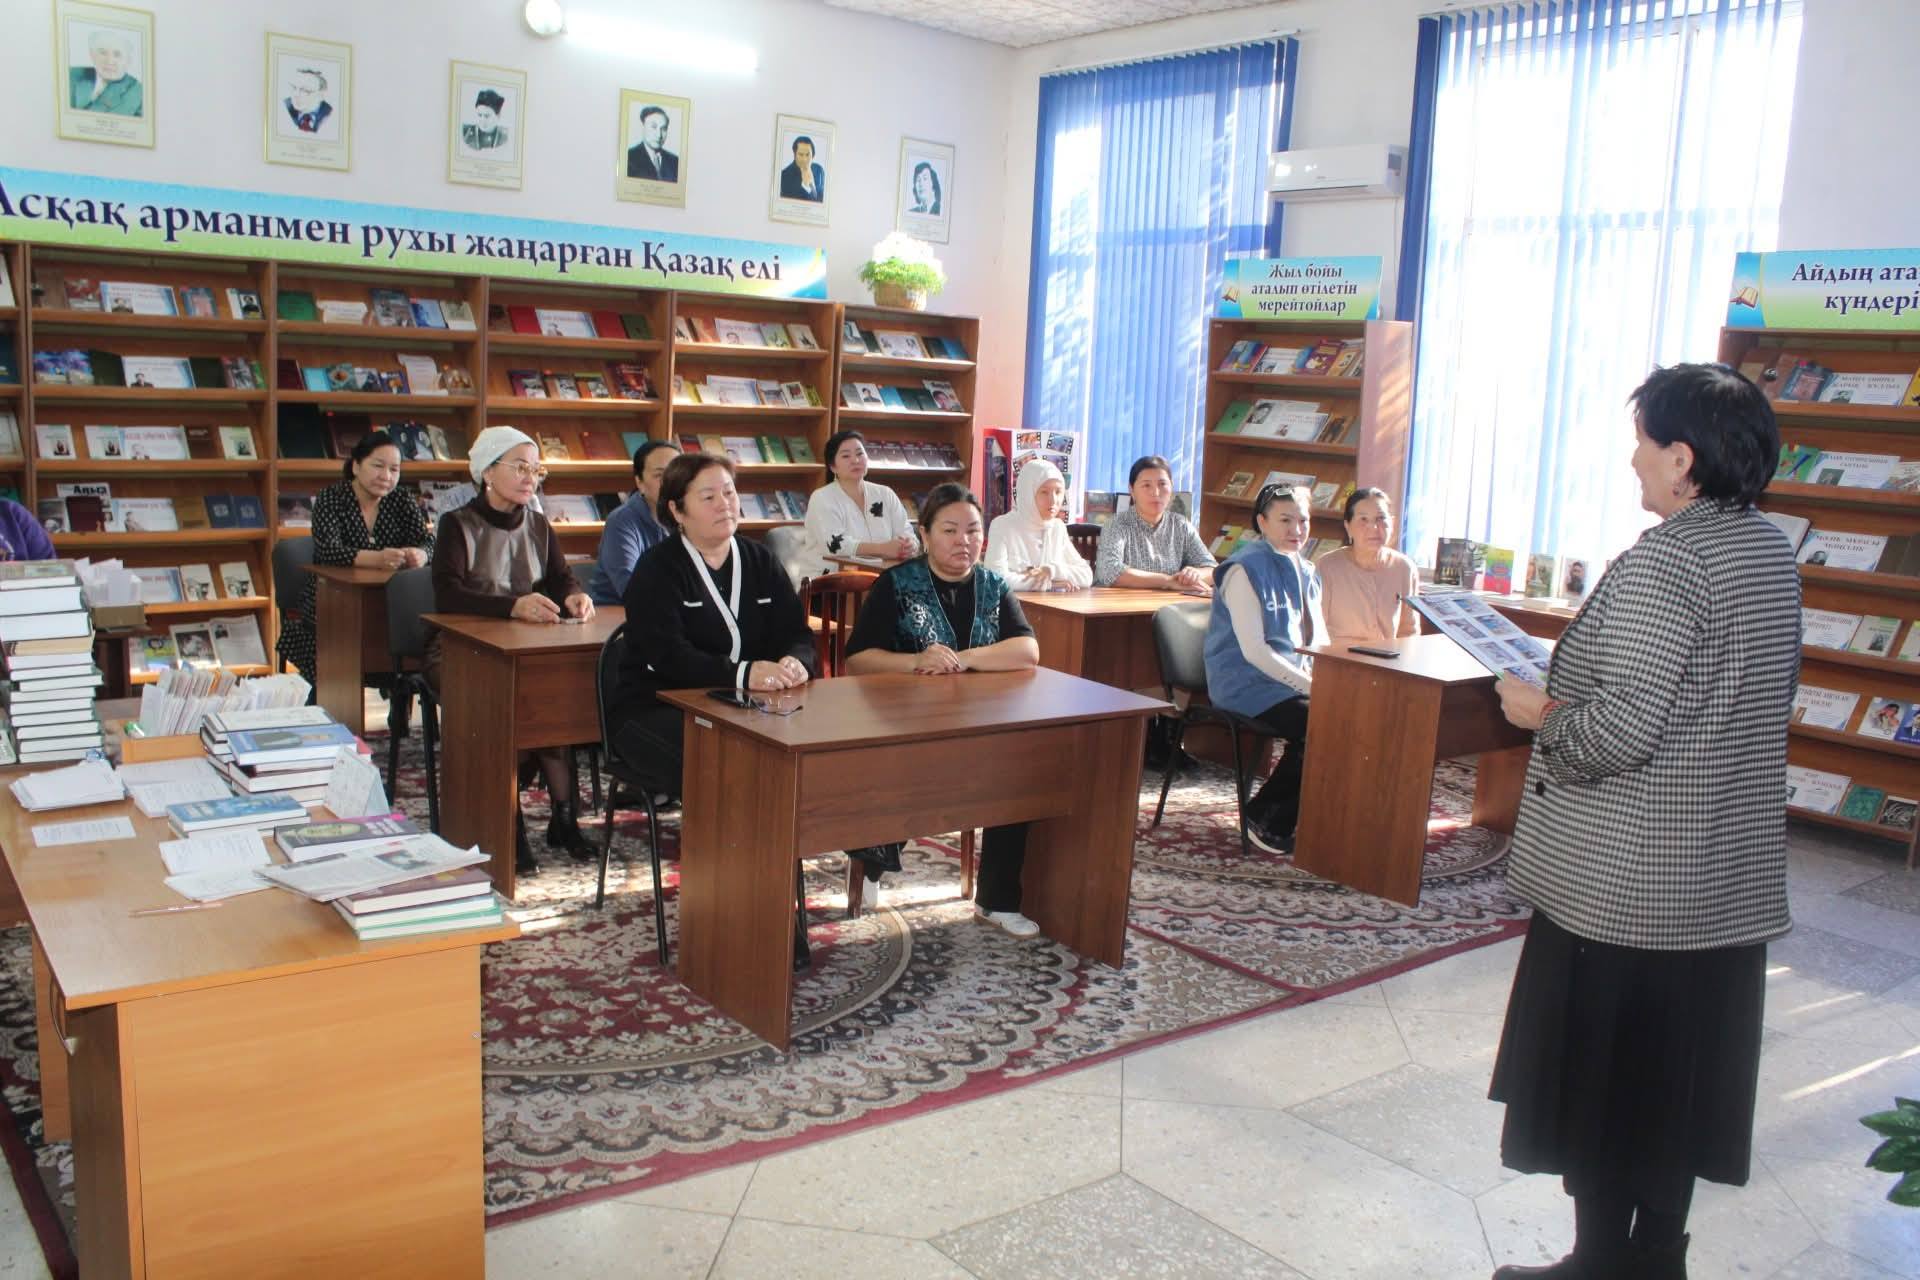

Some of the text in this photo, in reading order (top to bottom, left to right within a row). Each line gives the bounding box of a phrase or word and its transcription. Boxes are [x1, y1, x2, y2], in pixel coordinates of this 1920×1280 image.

[139, 204, 350, 244] арманмен
[361, 225, 456, 259] рухы
[465, 233, 633, 272] жаңарған
[642, 241, 735, 282] Қазақ
[741, 254, 782, 282] елі
[1268, 262, 1342, 278] Жыл бойы
[1792, 262, 1920, 289] Айдың ата
[1251, 280, 1358, 295] аталып өтілетін
[1258, 298, 1347, 316] мерейтойлар
[1824, 290, 1920, 316] күндері
